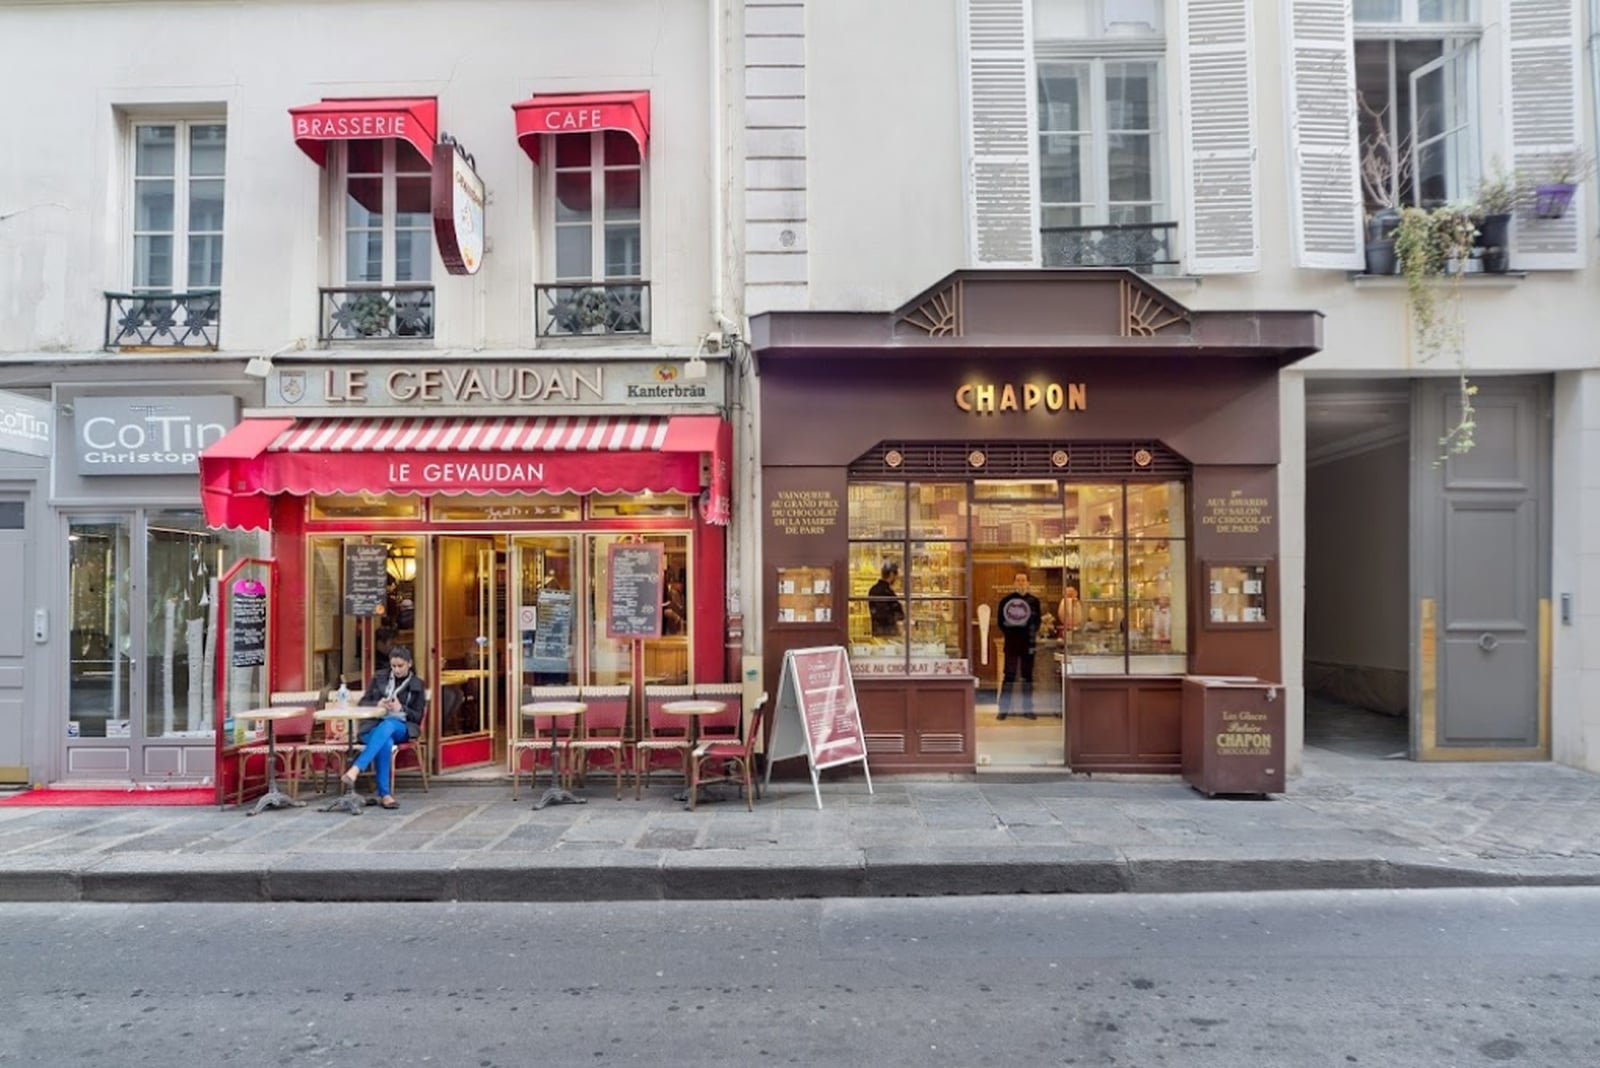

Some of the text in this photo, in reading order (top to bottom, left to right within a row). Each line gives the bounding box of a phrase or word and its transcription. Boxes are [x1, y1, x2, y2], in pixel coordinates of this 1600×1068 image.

[296, 116, 405, 136] BRASSERIE
[545, 109, 601, 129] CAFE
[324, 367, 604, 401] LE GEVAUDAN
[627, 384, 706, 398] Kanterbräu
[955, 383, 1087, 412] CHAPON
[0, 408, 49, 434] oTin
[84, 451, 202, 465] Christop
[389, 463, 544, 482] LE GEVAUDAN
[772, 509, 837, 517] DU CHOCOLAT
[1202, 516, 1272, 524] DU CHOCOLAT
[789, 518, 800, 526] LA
[785, 527, 825, 535] DE PARIS
[1216, 734, 1272, 748] CHAPON
